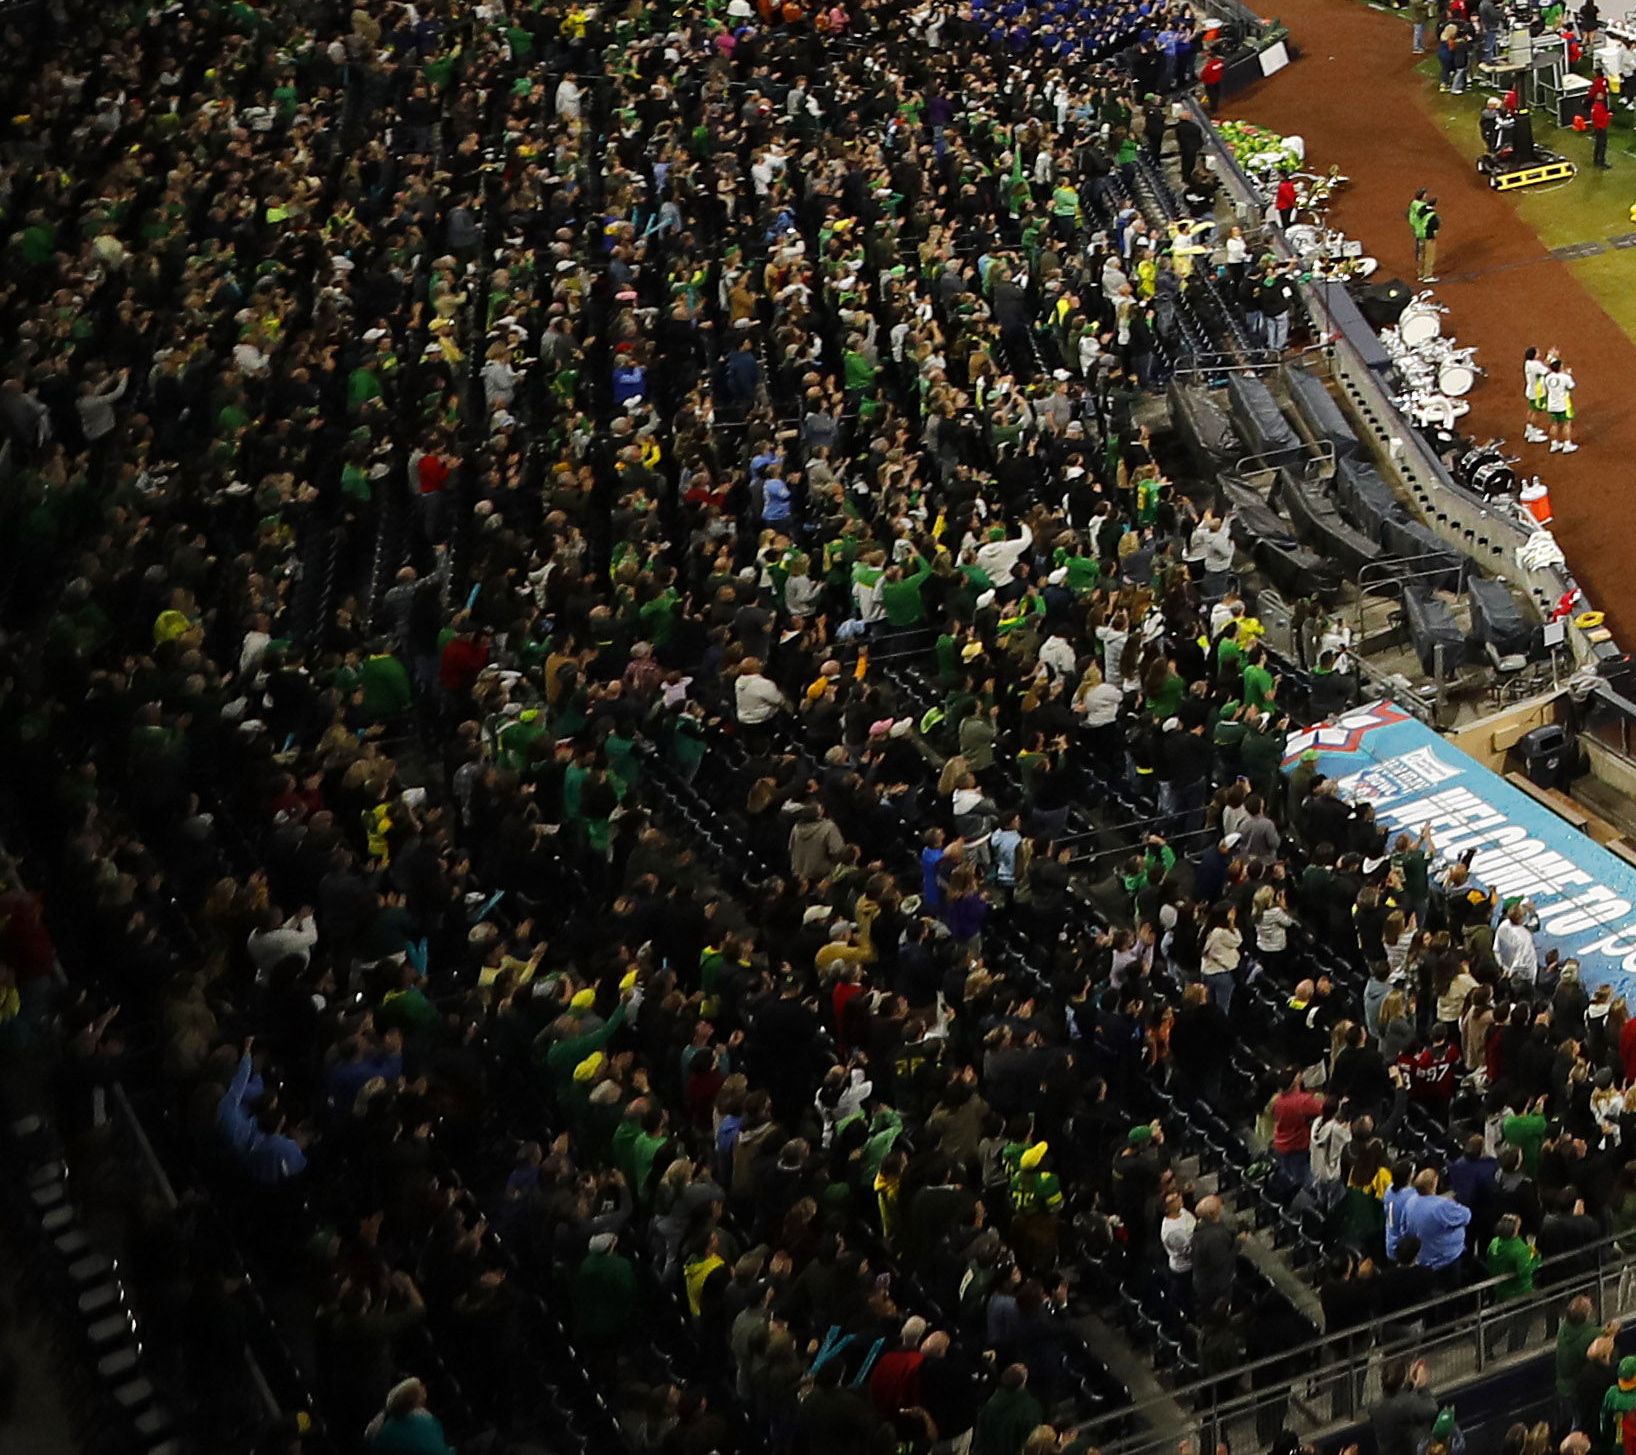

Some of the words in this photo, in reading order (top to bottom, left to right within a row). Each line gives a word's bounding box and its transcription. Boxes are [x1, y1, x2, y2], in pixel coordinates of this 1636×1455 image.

[1374, 785, 1594, 906] WELCOME
[1534, 883, 1633, 937] TO
[1425, 1062, 1450, 1083] 97
